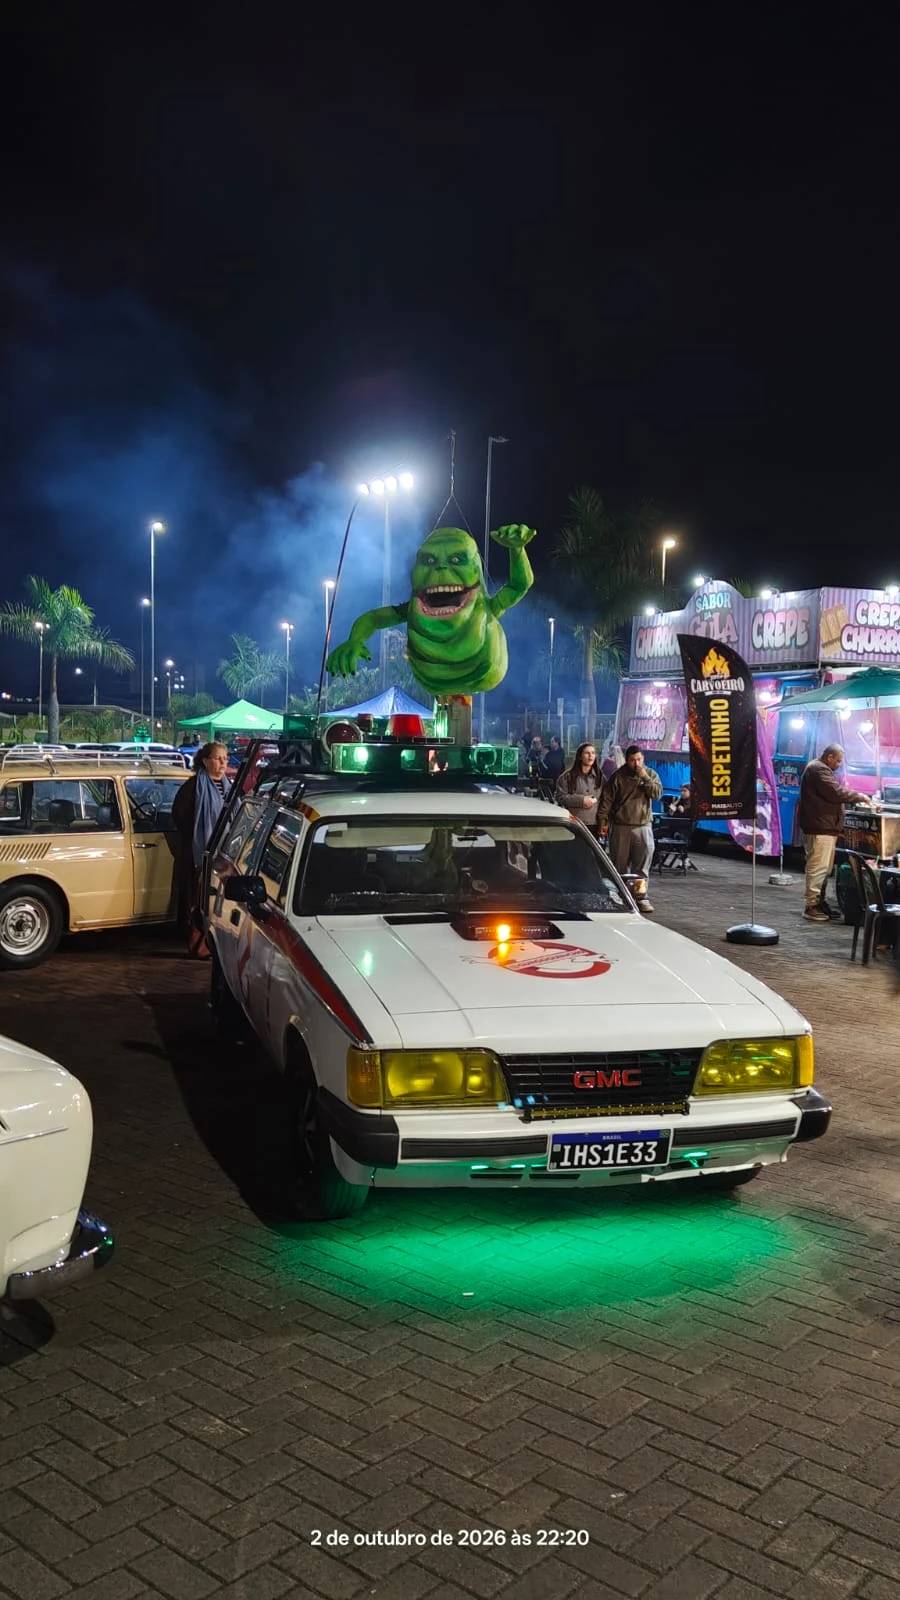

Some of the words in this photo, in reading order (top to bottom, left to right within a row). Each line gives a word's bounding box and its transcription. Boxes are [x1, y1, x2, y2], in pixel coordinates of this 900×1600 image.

[695, 591, 731, 613] SABOR
[752, 607, 811, 650] CREPE
[841, 624, 900, 656] CHURR
[690, 676, 745, 694] CARVOEIRO
[709, 698, 732, 797] ESPETINHO
[572, 1069, 641, 1089] GMC
[559, 1141, 658, 1167] IHS1E33
